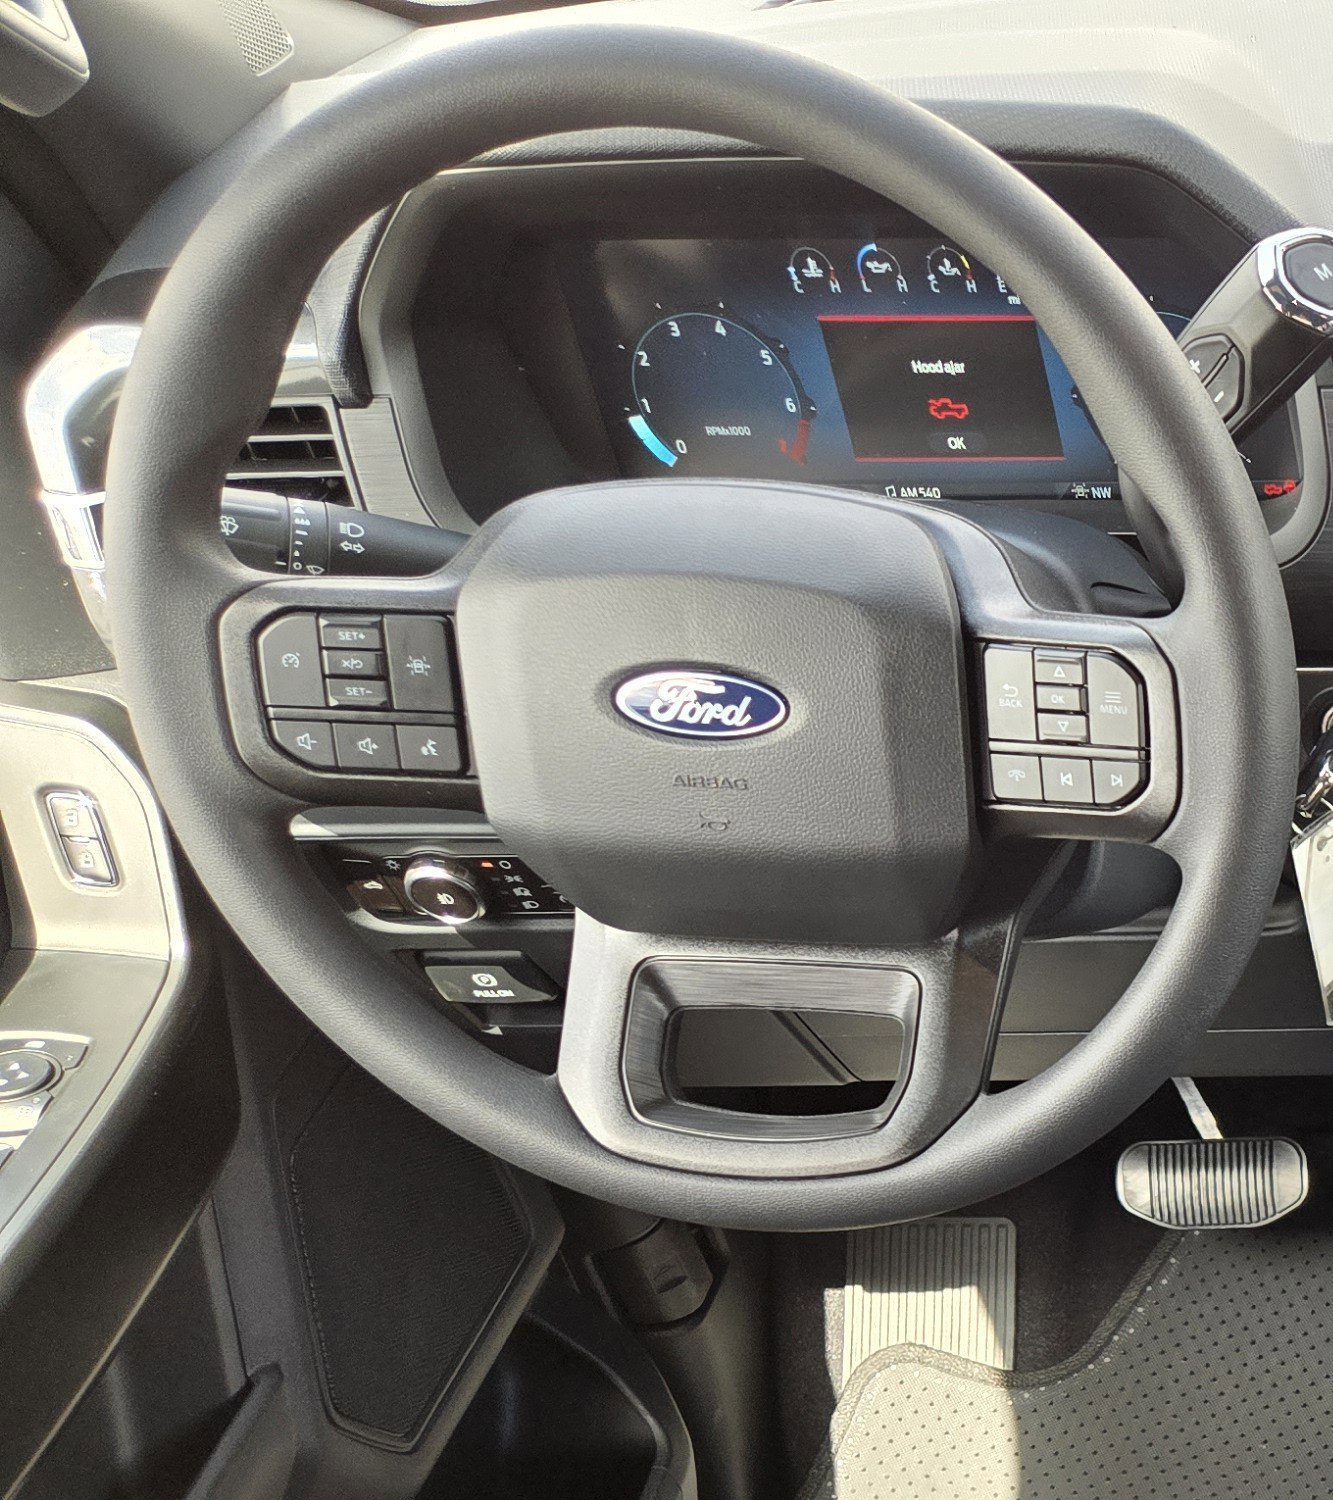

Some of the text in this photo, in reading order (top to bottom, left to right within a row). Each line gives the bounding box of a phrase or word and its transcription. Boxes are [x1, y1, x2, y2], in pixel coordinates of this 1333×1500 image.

[1312, 263, 1333, 281] M
[793, 279, 805, 294] C
[829, 279, 842, 294] H
[862, 279, 872, 293] L
[897, 279, 909, 293] H
[930, 279, 941, 294] C
[966, 279, 978, 294] H
[667, 321, 681, 337] 3
[714, 319, 727, 337] 4
[637, 350, 650, 367] 2
[760, 349, 773, 366] 5
[911, 359, 966, 376] Hood ajar
[641, 397, 652, 414] 1
[784, 397, 797, 413] 6
[675, 438, 688, 454] 0
[946, 436, 967, 450] OK
[900, 487, 941, 499] AM 540
[1090, 486, 1113, 499] NW
[337, 630, 366, 642] SET+
[649, 677, 752, 727] Ford
[999, 698, 1024, 709] BACK
[1051, 694, 1066, 705] OK
[1100, 704, 1128, 716] MENU
[672, 773, 748, 791] AIRBAG
